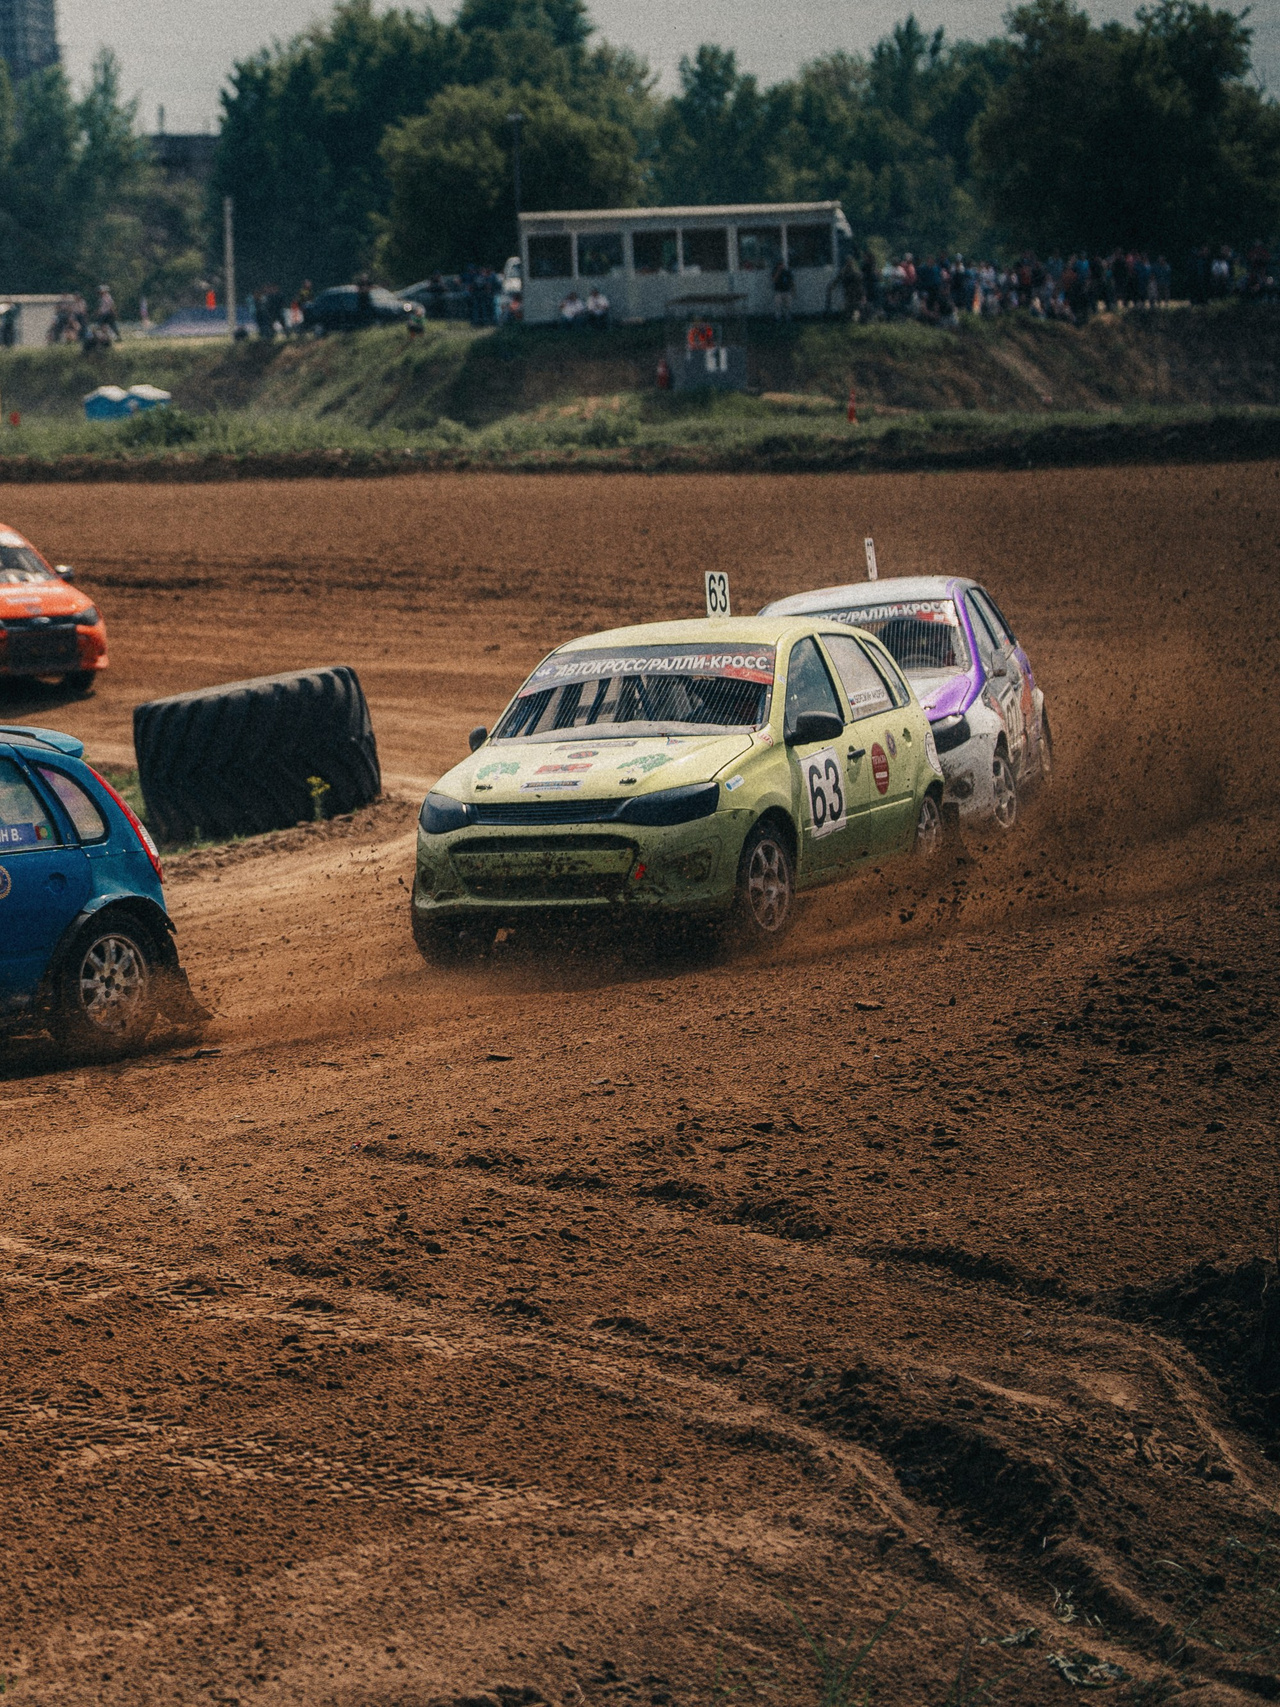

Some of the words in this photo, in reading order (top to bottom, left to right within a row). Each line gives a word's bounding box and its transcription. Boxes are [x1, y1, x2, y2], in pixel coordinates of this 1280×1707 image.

[708, 574, 727, 613] 63
[808, 758, 843, 829] 63
[11, 827, 23, 842] В.
